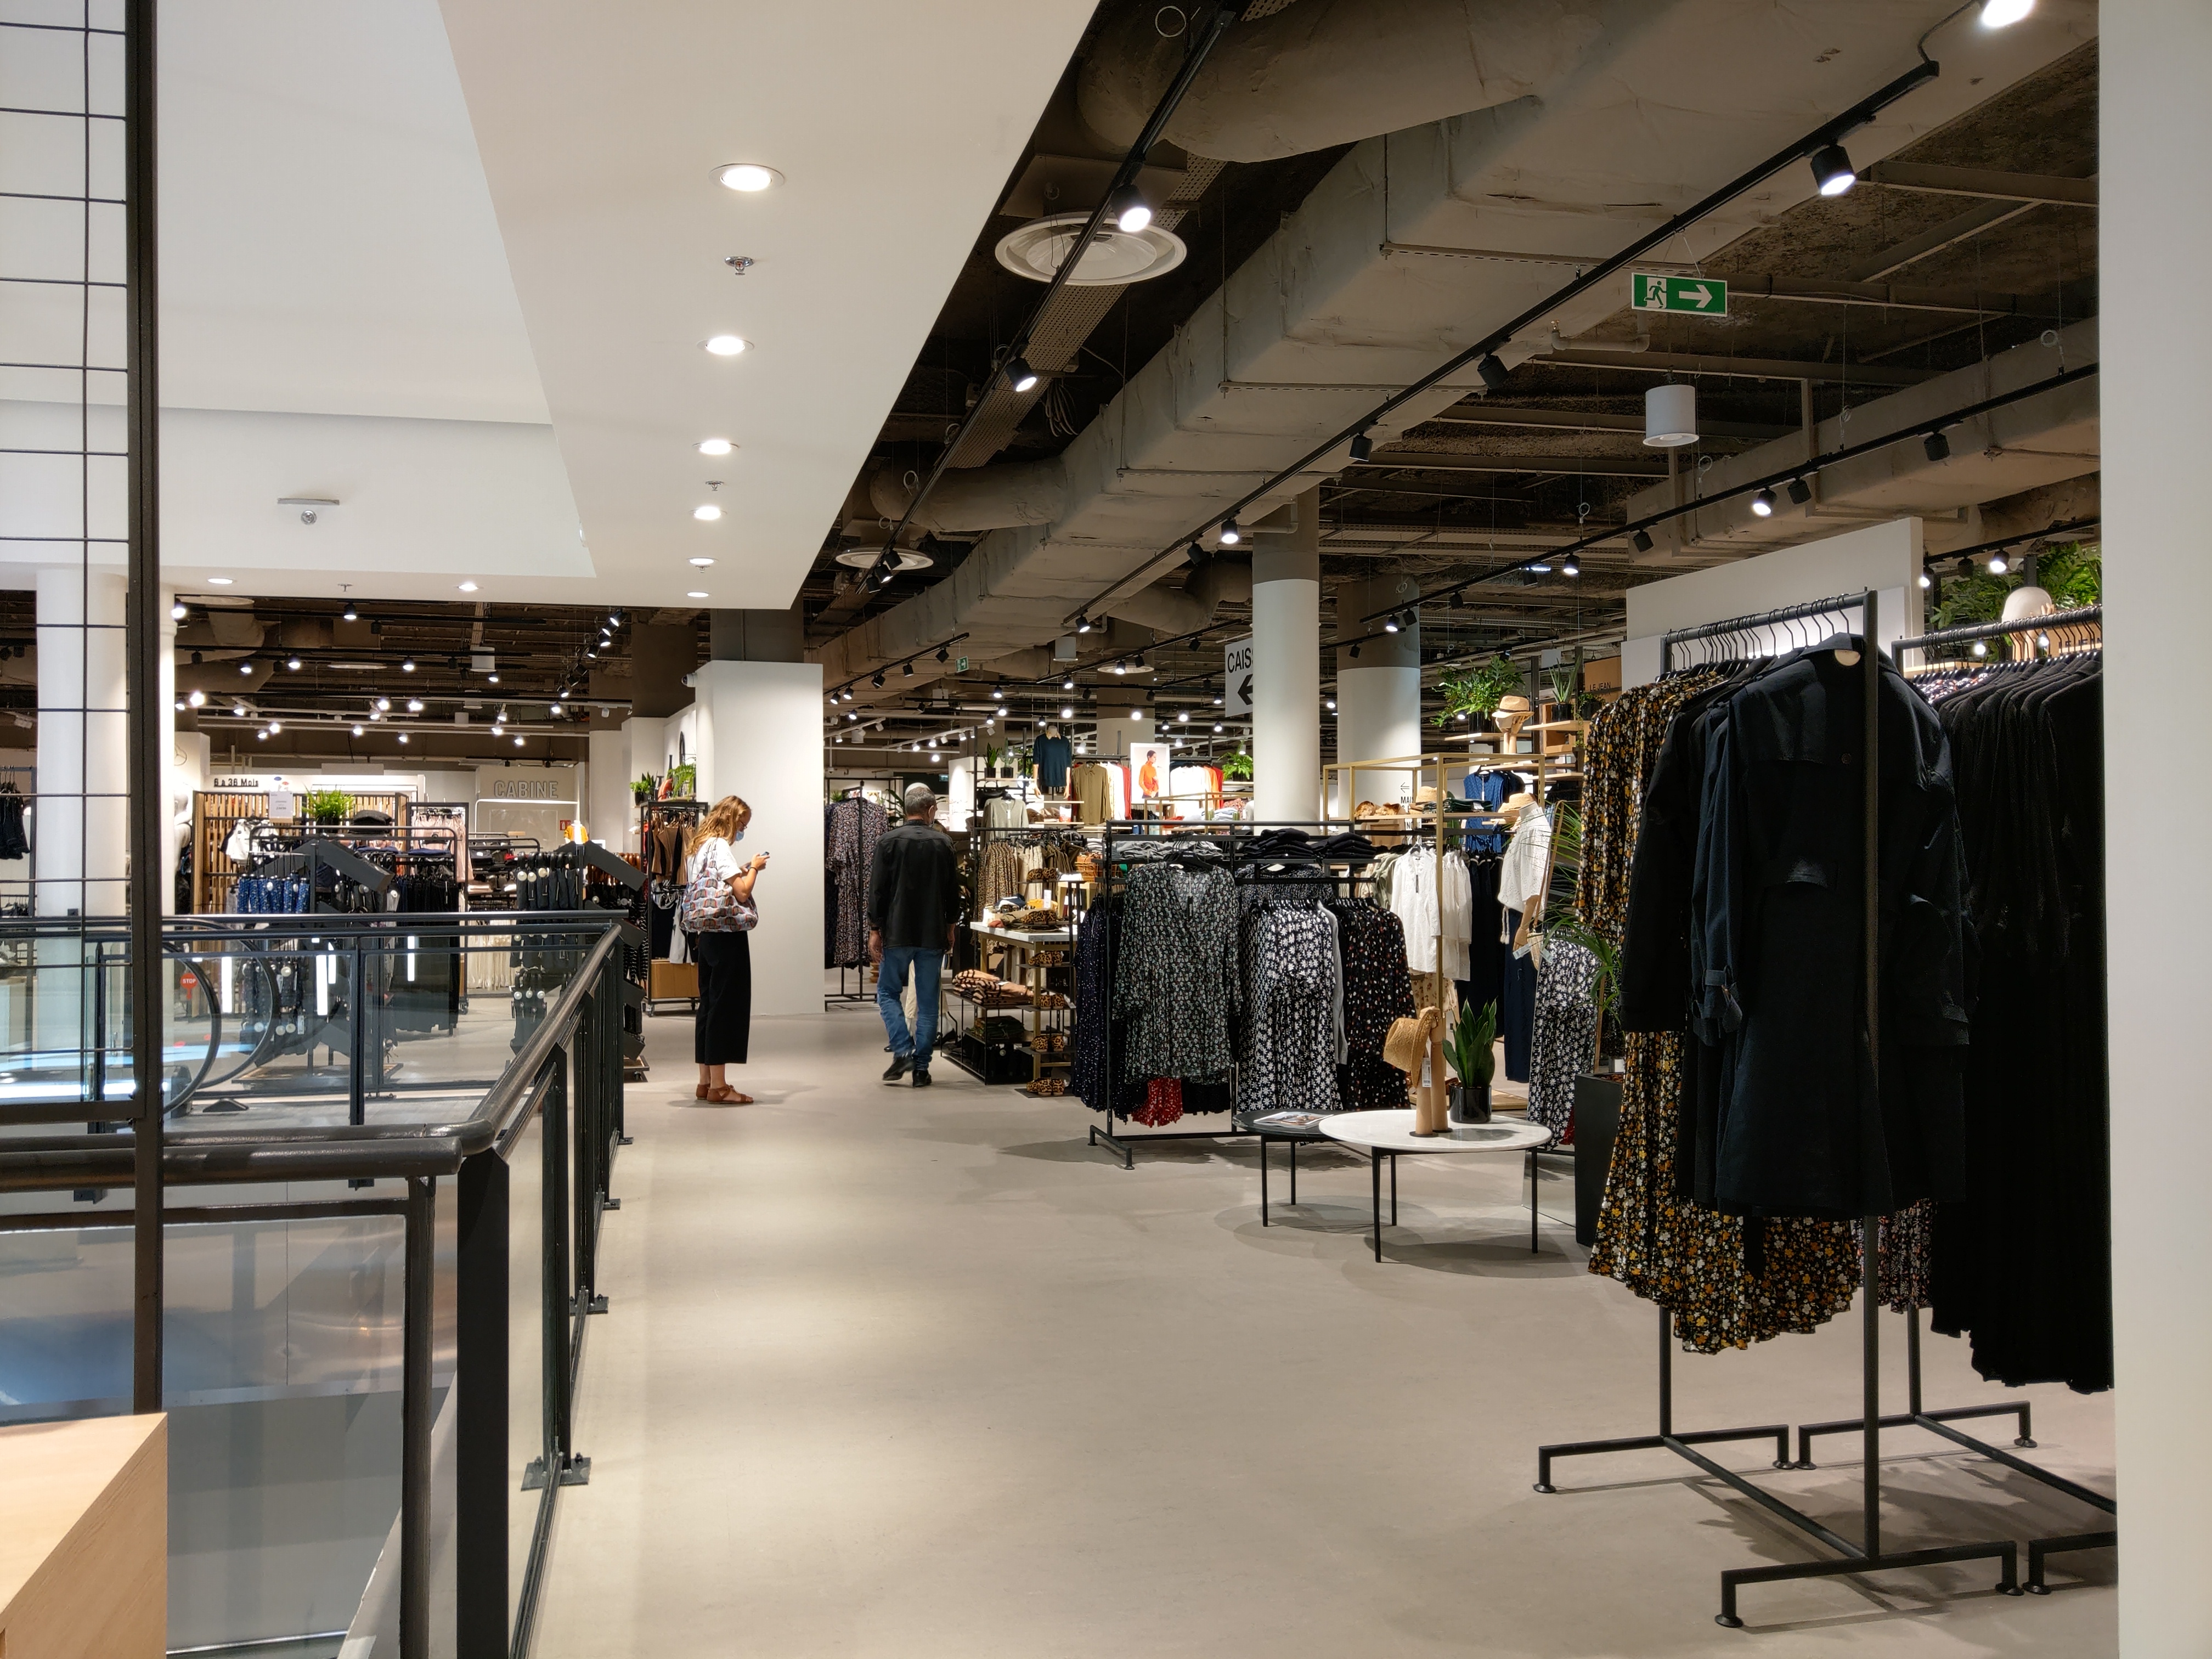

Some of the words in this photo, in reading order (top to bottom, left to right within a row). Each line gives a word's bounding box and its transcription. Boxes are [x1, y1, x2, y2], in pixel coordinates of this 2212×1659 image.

[1228, 647, 1253, 673] CAIS
[1597, 681, 1611, 691] JEAN
[214, 778, 219, 787] 6
[228, 778, 238, 787] 36
[241, 778, 258, 787] Mois
[494, 780, 558, 799] CABINE
